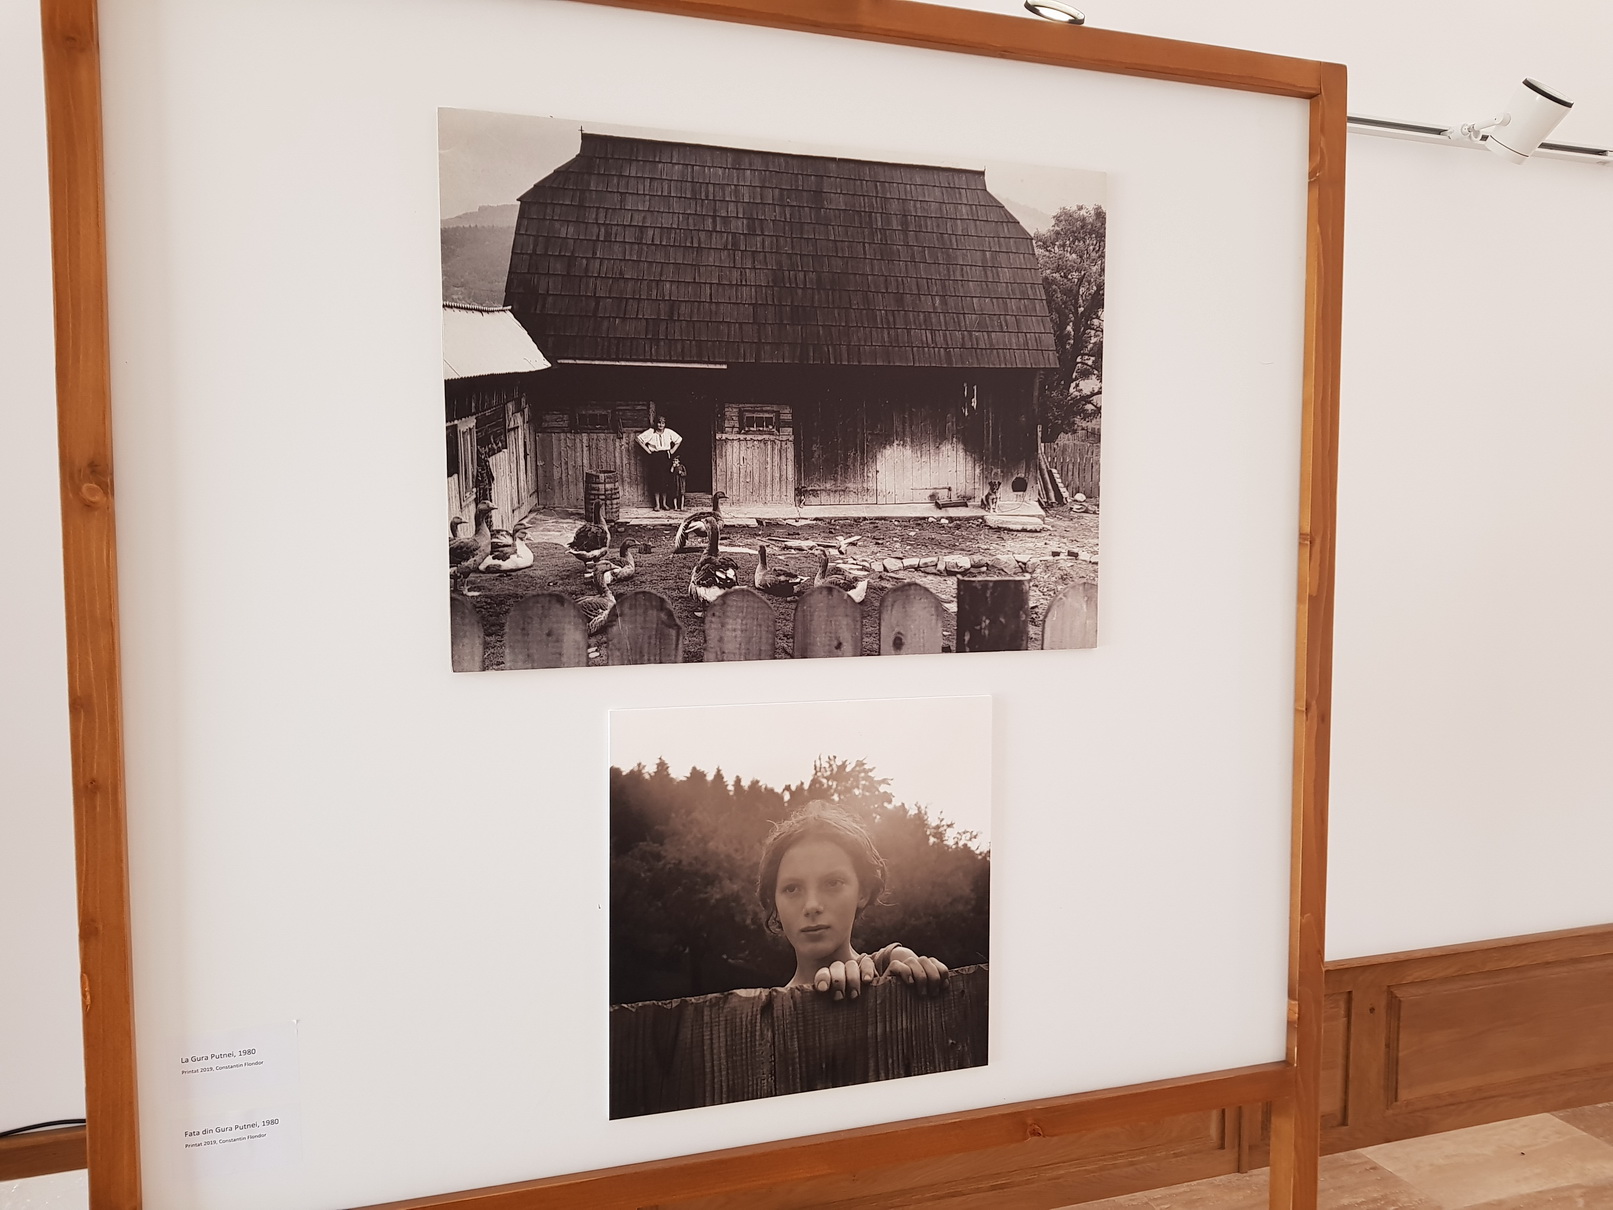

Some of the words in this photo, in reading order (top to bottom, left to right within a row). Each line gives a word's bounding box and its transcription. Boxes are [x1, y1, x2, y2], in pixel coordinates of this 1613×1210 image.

[210, 1051, 236, 1060] Putnei,
[238, 1048, 257, 1057] 1980
[234, 1121, 260, 1131] Putnei,
[261, 1118, 280, 1127] 1980
